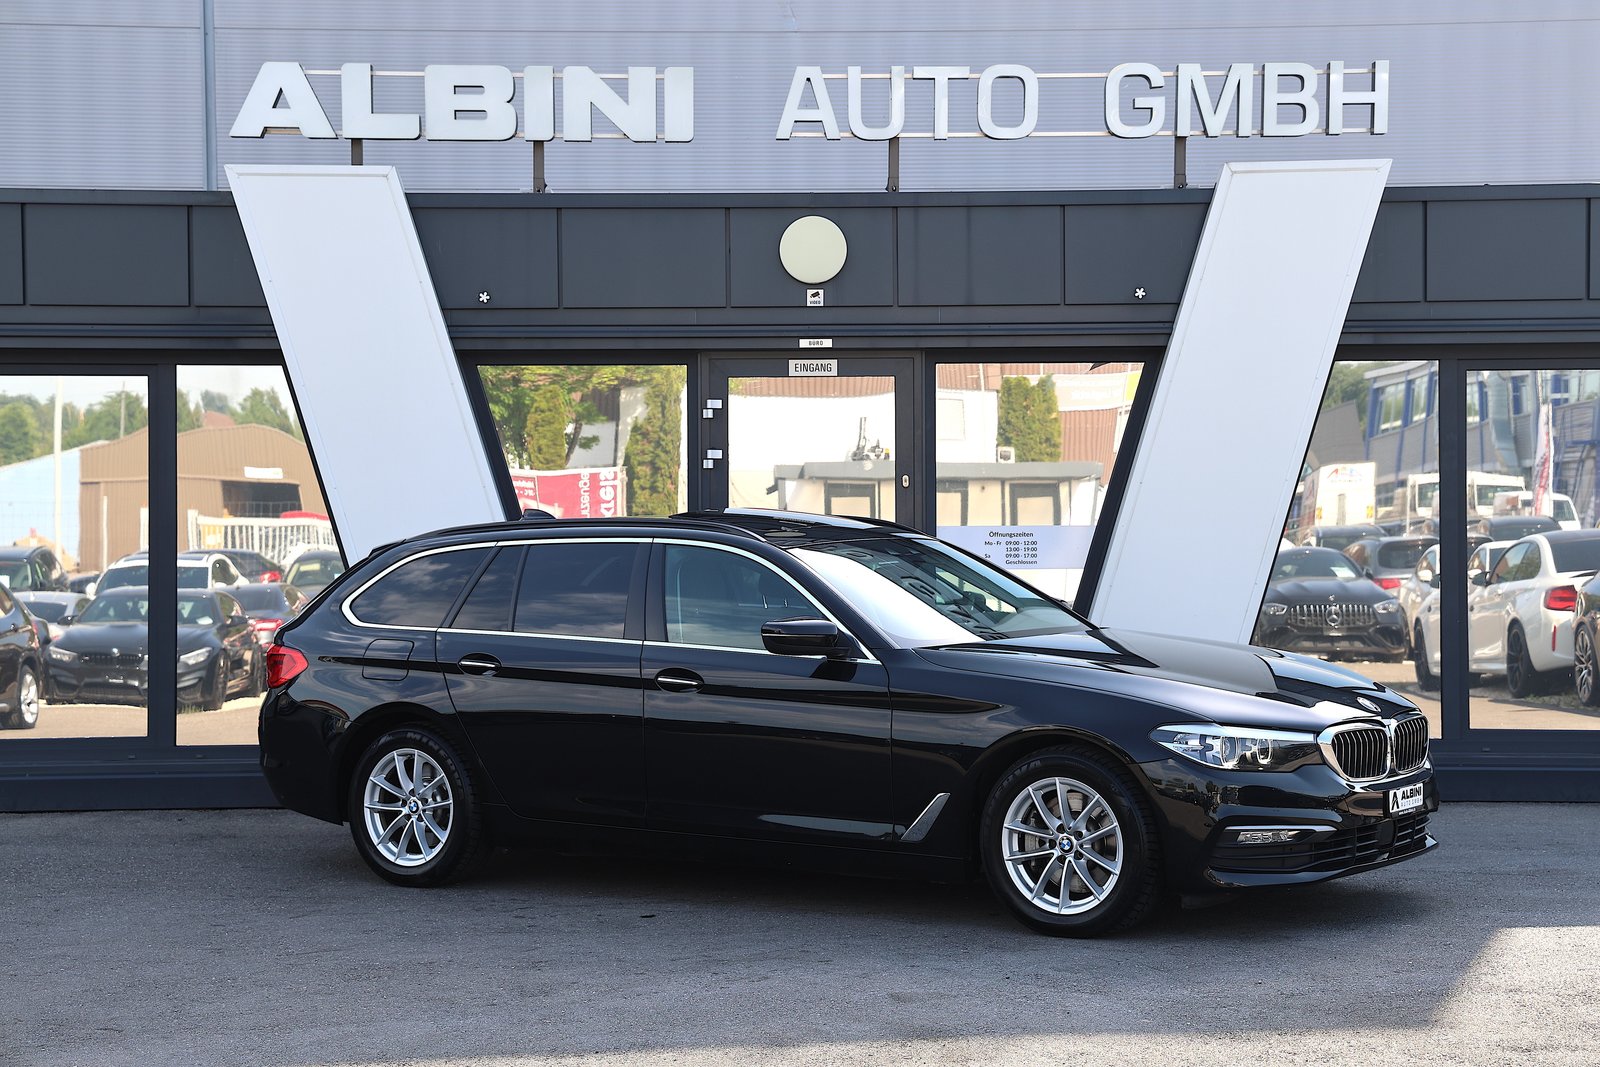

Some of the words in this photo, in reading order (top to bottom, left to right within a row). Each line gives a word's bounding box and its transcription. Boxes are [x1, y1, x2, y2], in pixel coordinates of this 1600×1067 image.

[229, 61, 694, 143] ALBINI
[775, 64, 1039, 141] AUTO
[1104, 60, 1390, 139] GMBH
[794, 363, 832, 373] EINGANG
[1401, 786, 1422, 801] ALBINI
